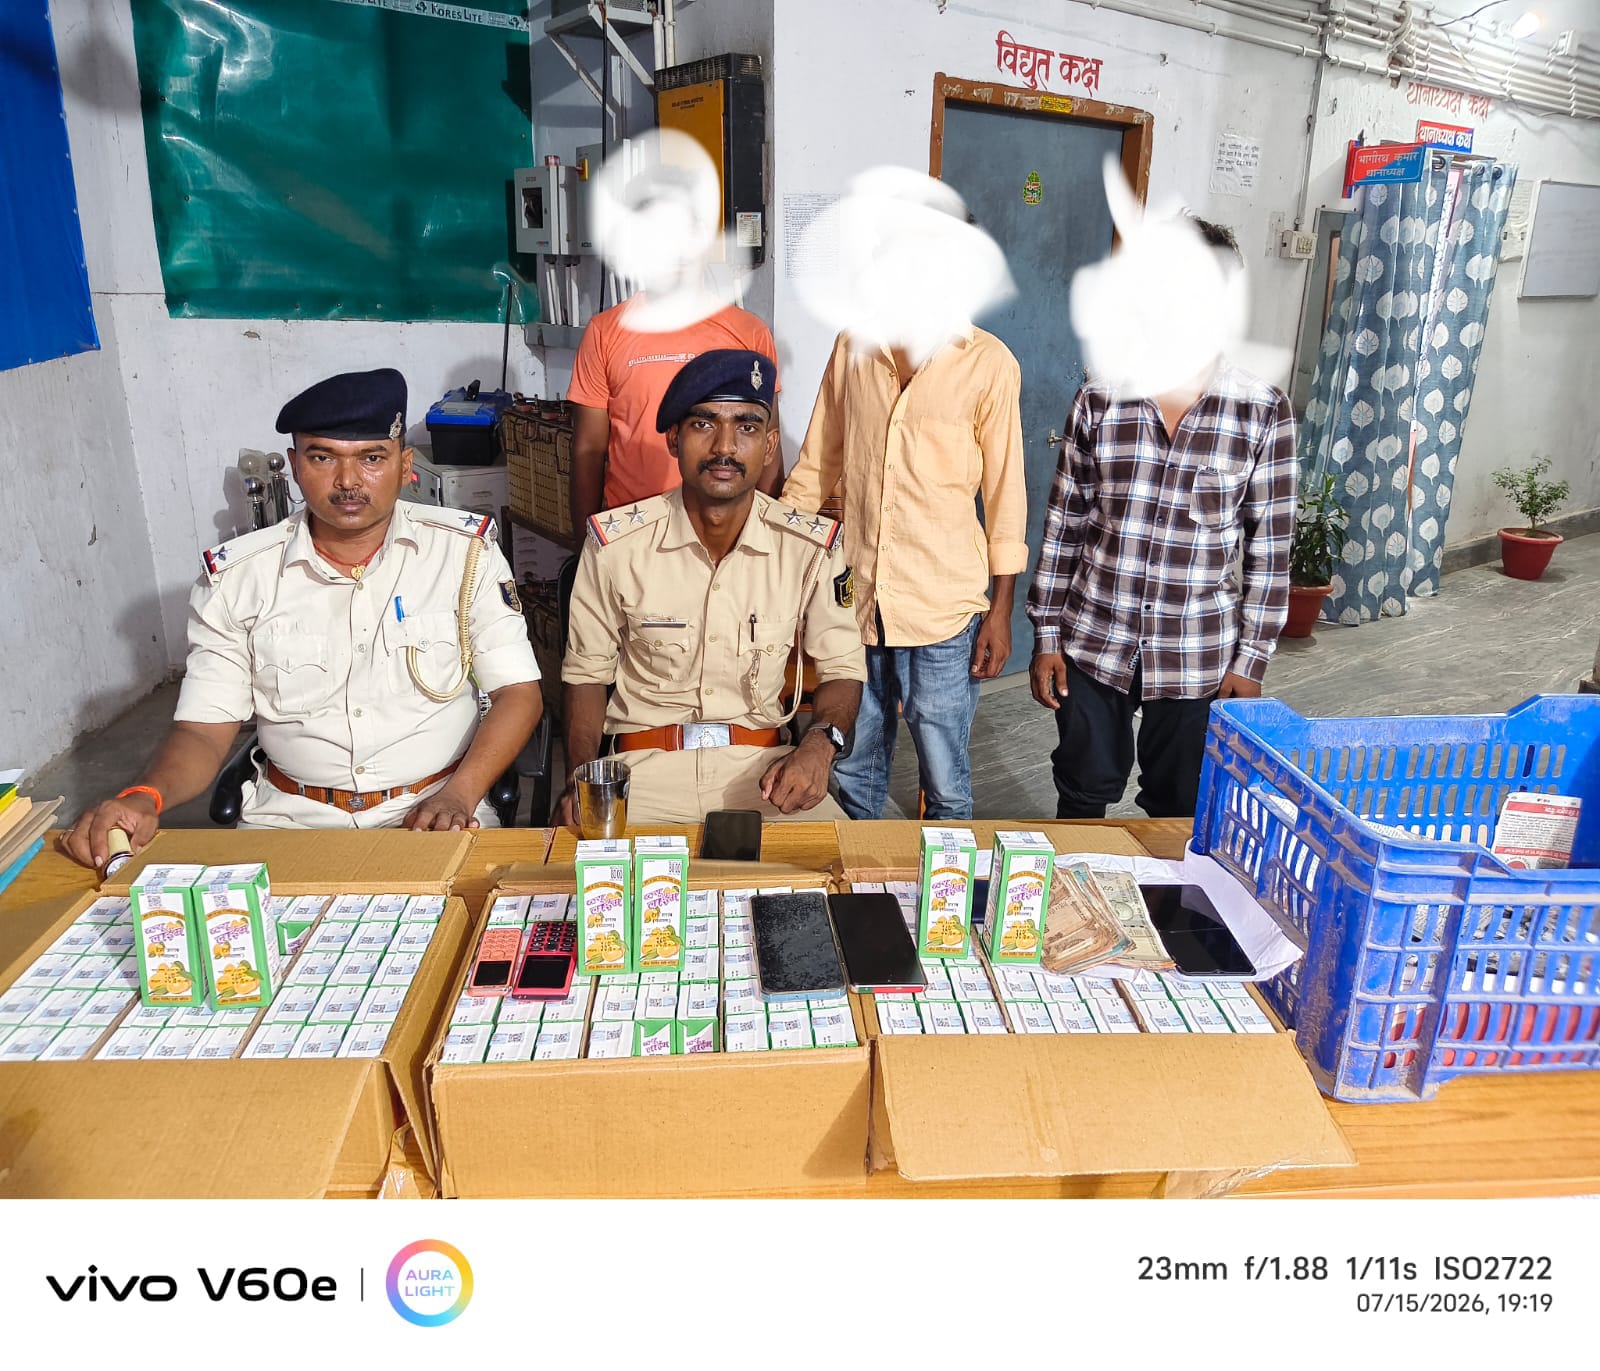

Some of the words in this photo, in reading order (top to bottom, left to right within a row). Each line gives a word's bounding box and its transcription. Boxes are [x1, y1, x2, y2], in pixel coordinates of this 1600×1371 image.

[995, 30, 1055, 90] विद्युत
[1059, 53, 1103, 97] कक्ष
[1394, 152, 1419, 167] कुमार
